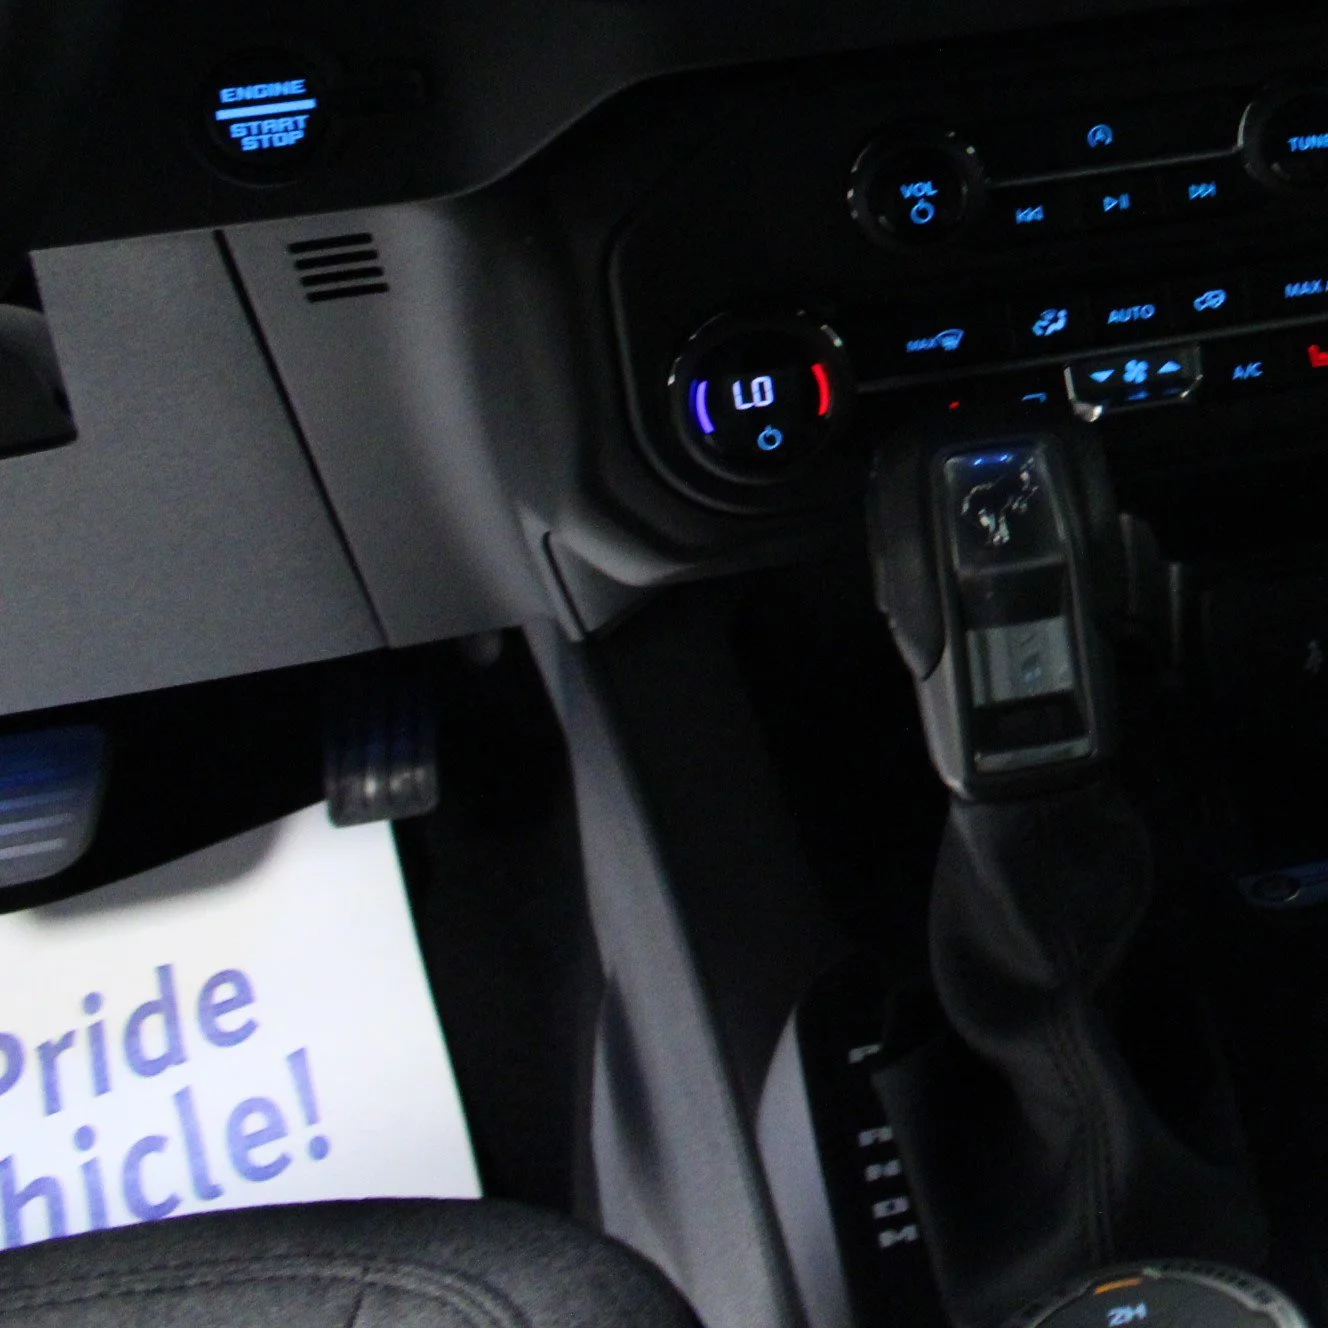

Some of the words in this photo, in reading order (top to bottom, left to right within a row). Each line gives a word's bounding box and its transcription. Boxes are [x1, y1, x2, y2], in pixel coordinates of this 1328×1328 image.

[219, 79, 307, 103] ENGINE
[229, 115, 310, 138] START
[241, 130, 304, 152] STOP
[900, 180, 938, 199] VOL
[1284, 279, 1323, 298] MAX
[1107, 304, 1156, 324] AUTO
[1232, 361, 1263, 380] A/C
[0, 1047, 332, 1247] hicle!
